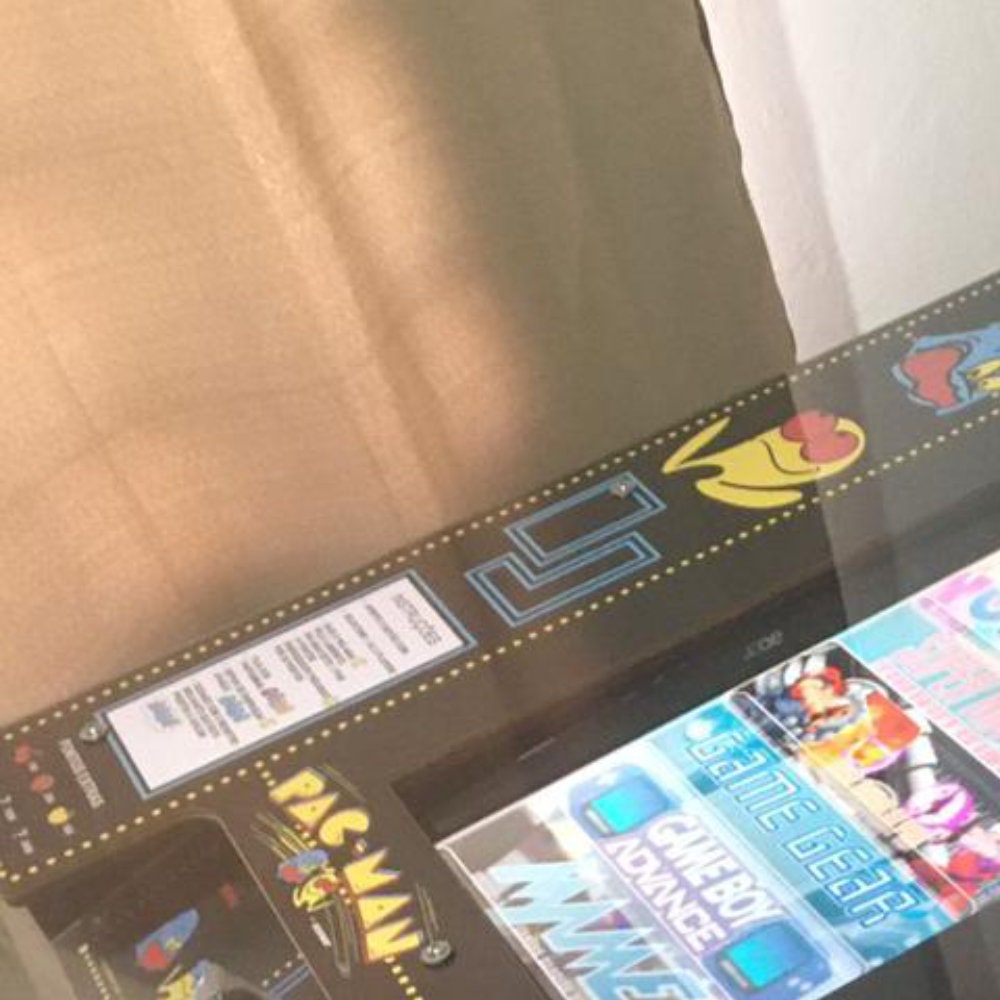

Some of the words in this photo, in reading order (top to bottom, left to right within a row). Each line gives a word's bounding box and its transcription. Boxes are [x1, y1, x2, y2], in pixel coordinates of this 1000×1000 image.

[606, 836, 727, 952] ADVANCE
[653, 812, 739, 887] GAME
[701, 873, 786, 929] BOY
